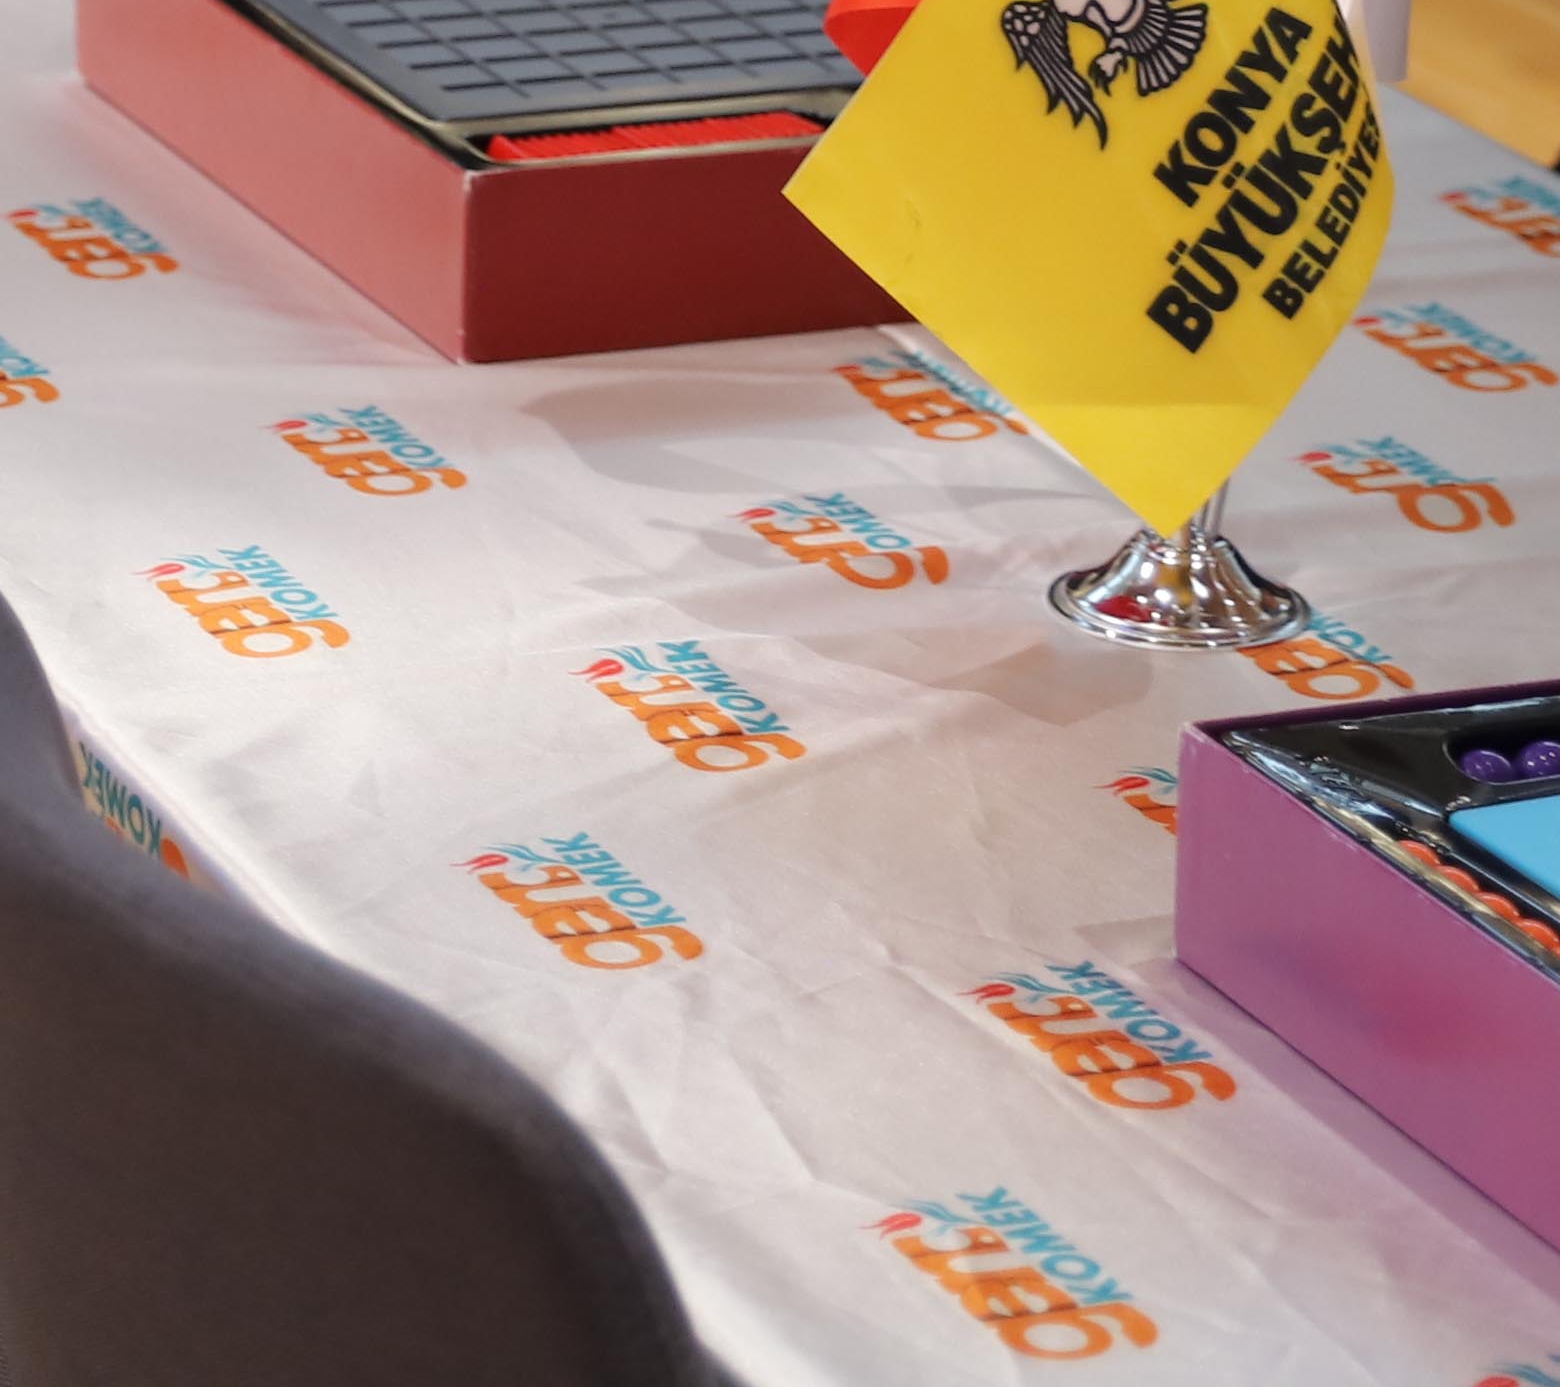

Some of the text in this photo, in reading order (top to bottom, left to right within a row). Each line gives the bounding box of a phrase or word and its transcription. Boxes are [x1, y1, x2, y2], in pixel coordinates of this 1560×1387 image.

[1152, 6, 1313, 209] KONYA
[13, 217, 180, 282] genç
[1362, 321, 1560, 394] genç
[1416, 303, 1538, 363] KOMEK
[338, 404, 448, 470] KOMEK
[830, 361, 1030, 442] genç
[280, 424, 469, 497] genç
[803, 492, 911, 549] OMEK
[156, 571, 351, 659] genç
[216, 544, 341, 620] KOMEK
[597, 673, 807, 773] genç
[658, 639, 792, 735] KOMEK
[78, 741, 162, 872] KOMEK
[478, 861, 706, 971] genç
[540, 831, 688, 927] KOMEK
[986, 989, 1238, 1112] genç
[1045, 960, 1214, 1064] KOMEK
[892, 1223, 1161, 1361] genç
[954, 1185, 1135, 1305] KOMEK
